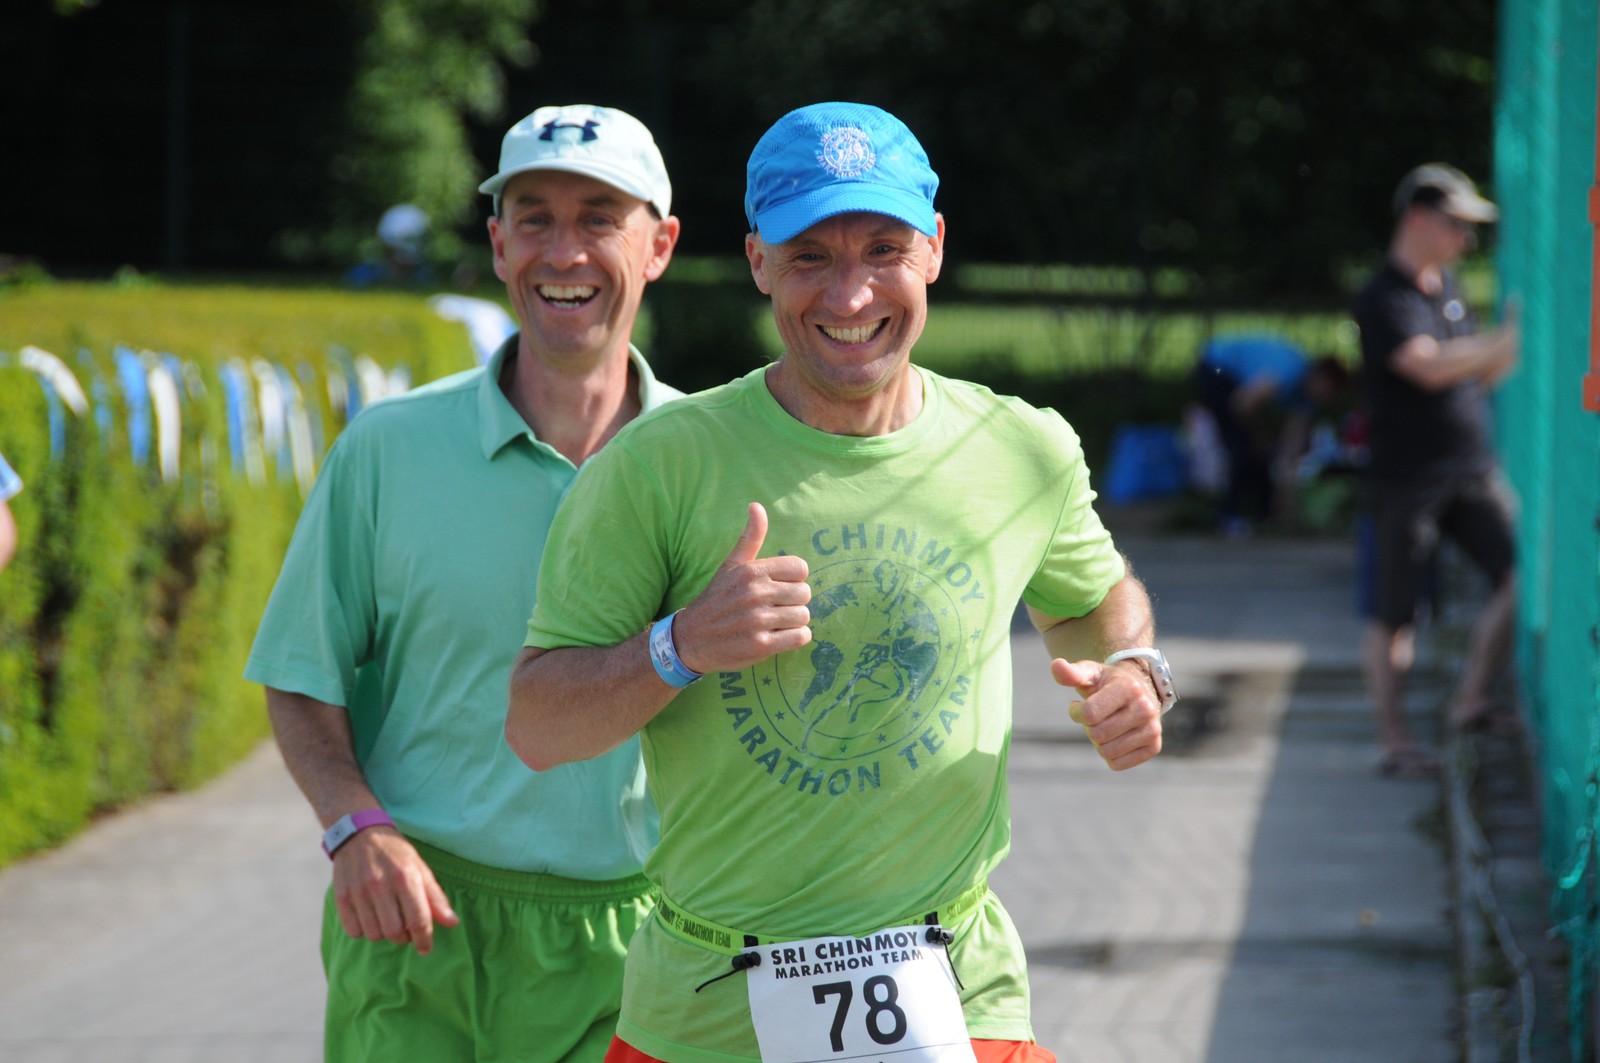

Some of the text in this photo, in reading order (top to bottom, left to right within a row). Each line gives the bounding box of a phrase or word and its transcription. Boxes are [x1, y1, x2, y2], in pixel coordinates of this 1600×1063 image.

[811, 522, 985, 602] CHINMOY
[719, 671, 972, 796] MARATHON TEAM
[683, 917, 731, 949] MARATHON TEAM
[771, 931, 918, 966] SRI CHINMOY
[775, 949, 924, 979] MARATHON TEAM
[812, 974, 908, 1053] 78
